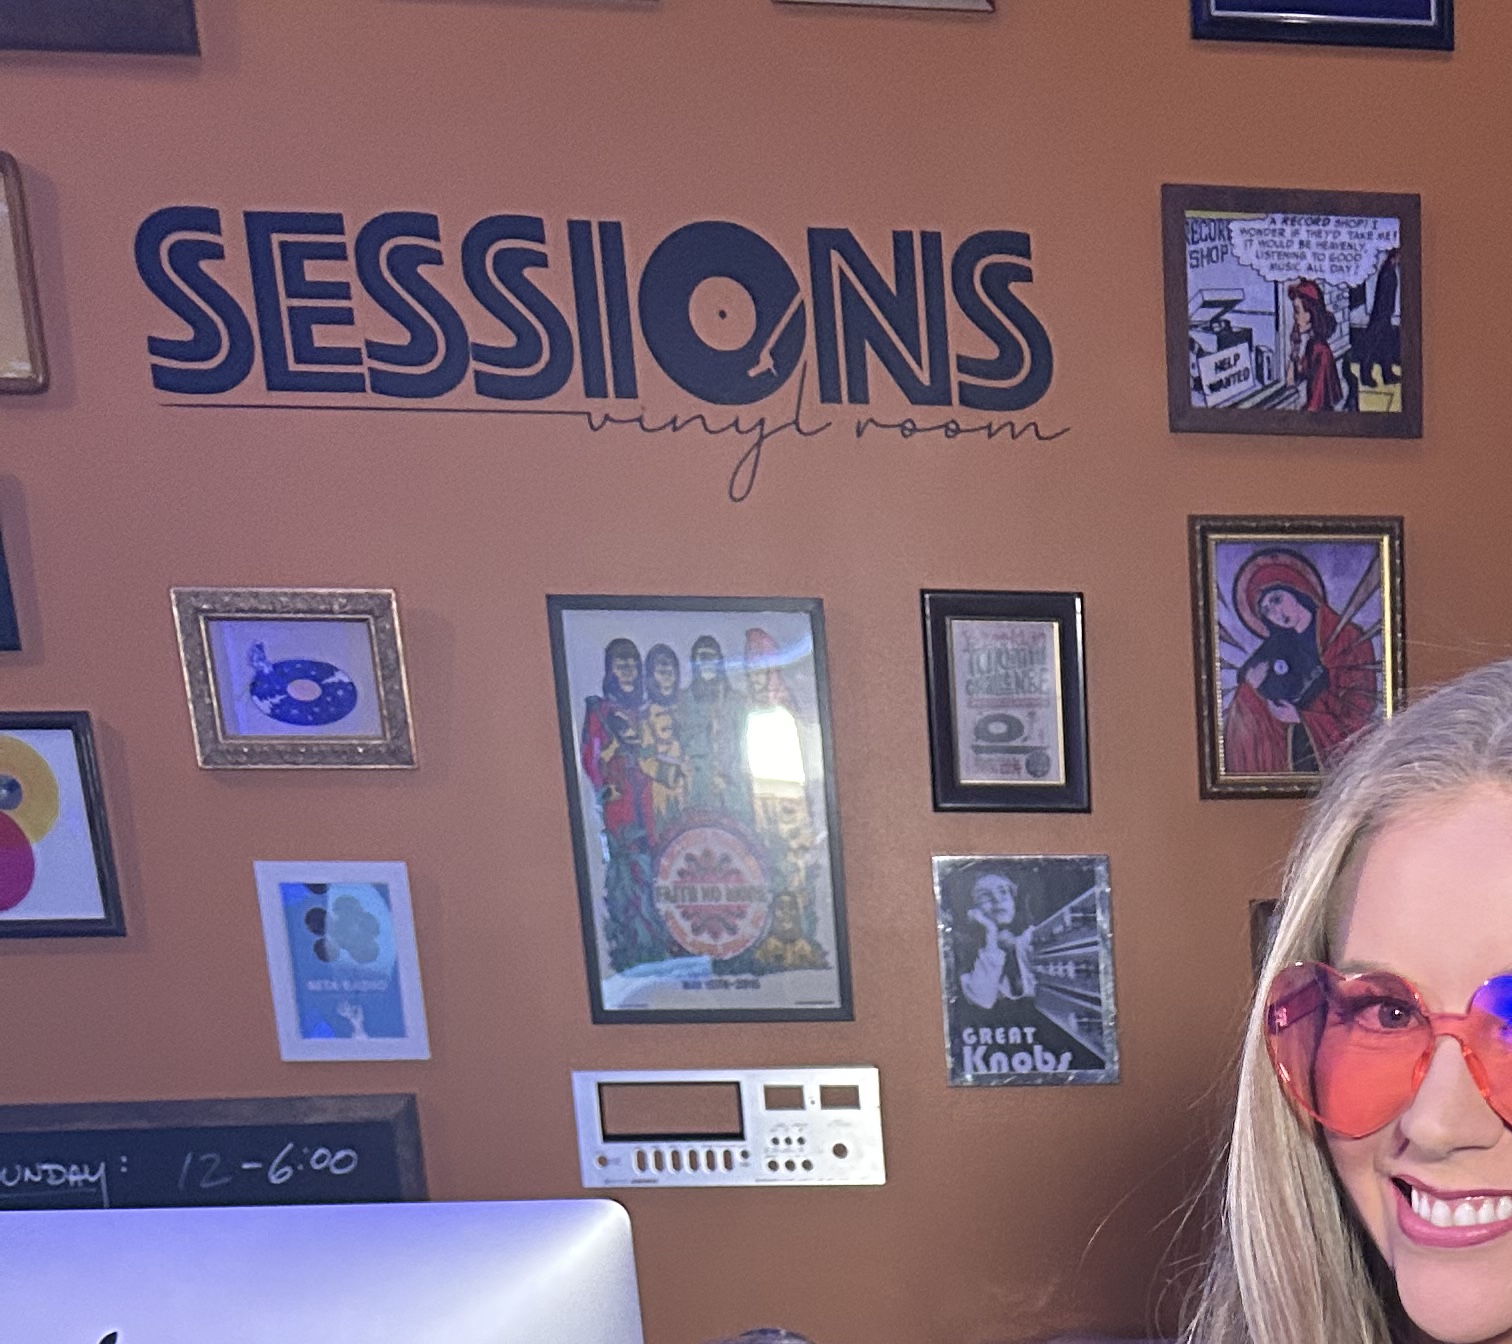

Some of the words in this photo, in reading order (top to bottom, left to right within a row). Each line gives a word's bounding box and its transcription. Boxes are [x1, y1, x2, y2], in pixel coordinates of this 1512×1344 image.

[1281, 216, 1331, 227] RECORD
[1239, 228, 1286, 238] WONDER
[1348, 231, 1374, 241] TAKE
[1258, 239, 1294, 249] WOULD
[1299, 240, 1311, 249] BE
[1189, 244, 1229, 269] SHOP
[1255, 250, 1307, 261] LISTENING
[1312, 251, 1325, 262] TO
[1328, 253, 1362, 263] GOOD
[1269, 262, 1301, 272] MUSIC
[1306, 263, 1325, 273] ALL
[134, 206, 1054, 412] SESSIONS
[1214, 353, 1241, 373] HELP
[1207, 367, 1251, 393] WANTED
[585, 365, 832, 502] vinyl
[856, 416, 1070, 441] room
[962, 1026, 1037, 1045] GREAT
[962, 1044, 1073, 1074] Knobs
